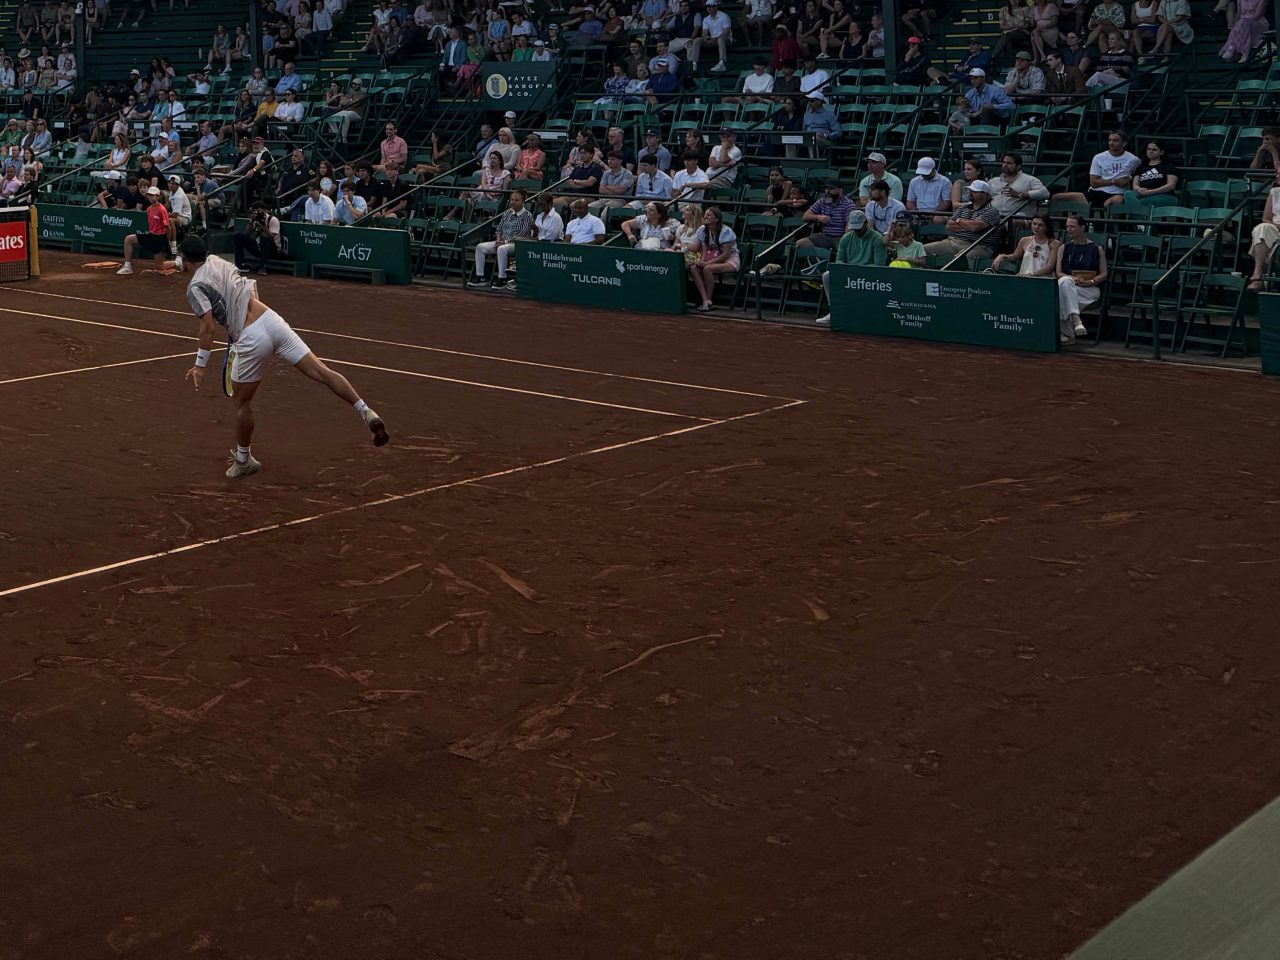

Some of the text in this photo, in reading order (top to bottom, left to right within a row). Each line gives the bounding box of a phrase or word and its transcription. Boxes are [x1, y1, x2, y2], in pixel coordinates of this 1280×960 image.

[1139, 172, 1164, 182] adidas
[108, 216, 133, 227] Fidelity
[309, 230, 328, 240] Cleary
[304, 237, 322, 246] Family
[527, 250, 583, 263] The Hildebrand
[542, 259, 568, 270] Family
[844, 276, 893, 292] Jefferies
[939, 285, 991, 296] Enterprise Products
[940, 291, 961, 299] Partners
[900, 301, 937, 310] AMERICANA
[891, 312, 932, 322] The Mithoff
[981, 312, 1034, 325] The Hackett
[900, 319, 924, 329] Family
[993, 321, 1023, 332] Family
